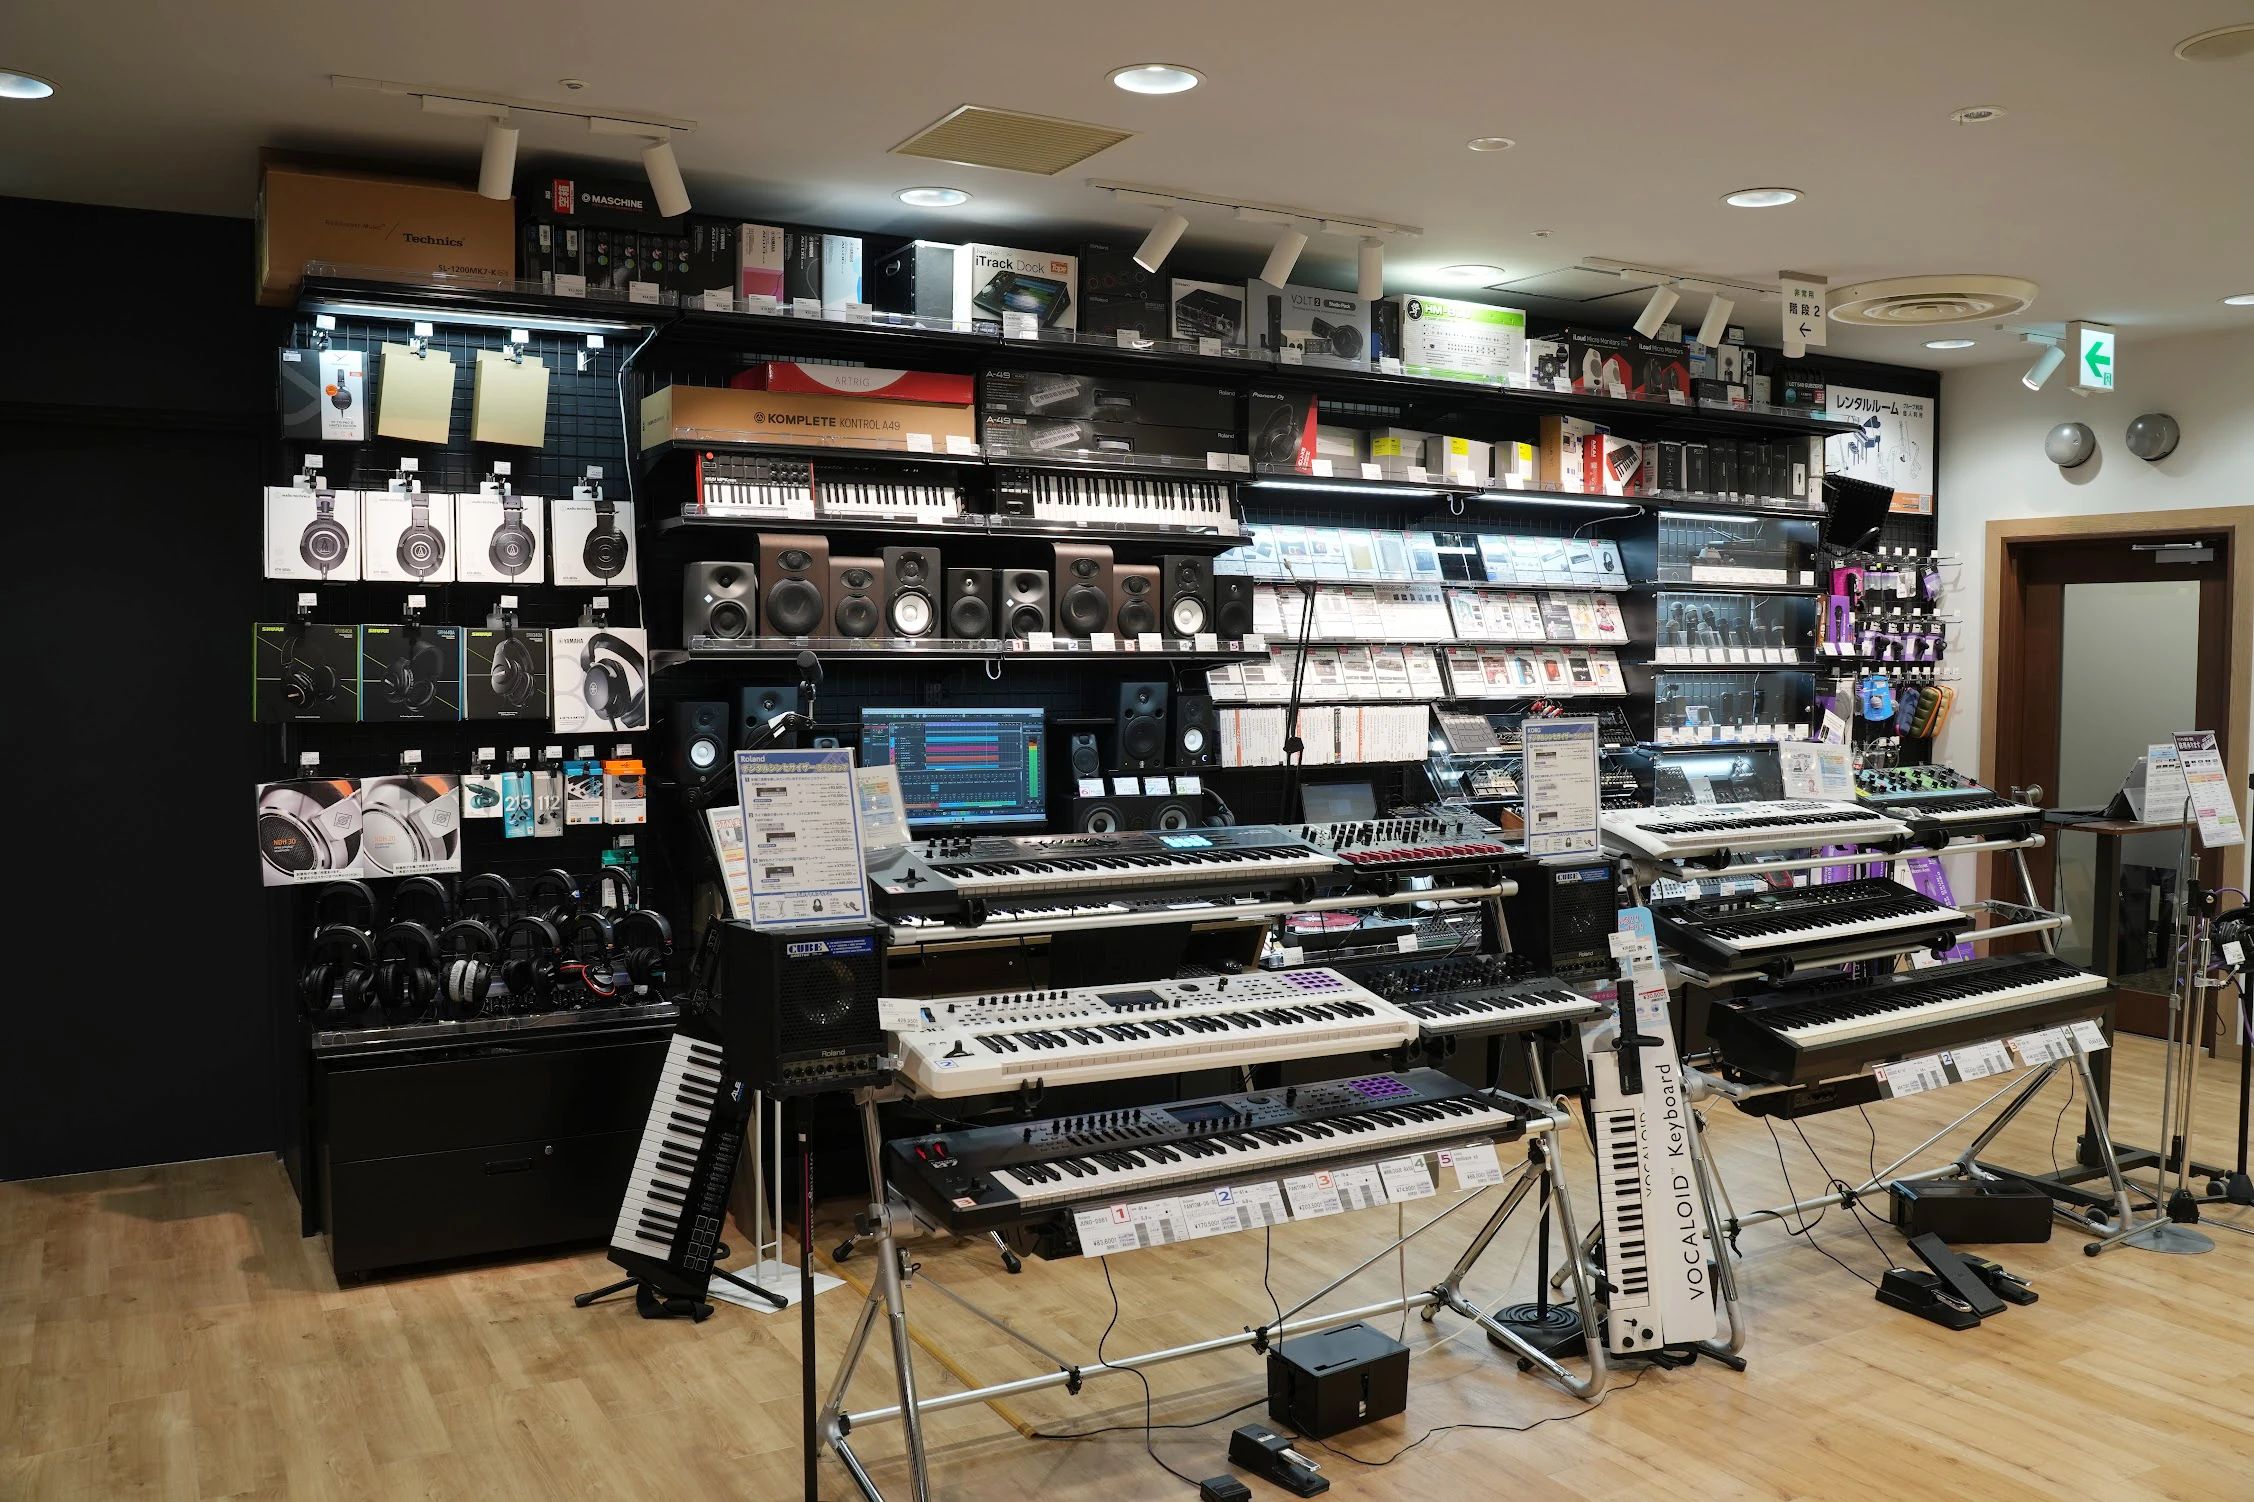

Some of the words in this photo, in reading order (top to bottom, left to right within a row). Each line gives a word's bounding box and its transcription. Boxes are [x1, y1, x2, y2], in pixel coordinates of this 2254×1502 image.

[592, 195, 643, 208] MASCHINE
[403, 233, 464, 247] Technics
[438, 264, 496, 276] SL-1200MK7-K
[975, 256, 1013, 270] iTrack
[1016, 260, 1045, 274] Dock
[1314, 298, 1320, 306] 2
[1573, 333, 1586, 342] iLoud
[1600, 338, 1620, 346] Monitors
[985, 370, 1011, 379] A-49
[1837, 394, 1899, 416] レンタルルーム
[768, 413, 836, 427] KOMPLETE
[839, 418, 881, 430] KONTROL
[882, 421, 900, 431] A49
[985, 416, 1011, 424] A-49
[505, 795, 532, 812] 215
[537, 795, 561, 810] 112
[1557, 873, 1579, 881] CUBE
[788, 943, 822, 953] CUBE
[2064, 1028, 2072, 1036] 4
[2011, 1042, 2018, 1050] 3
[821, 1049, 845, 1057] Roland
[1877, 1071, 1884, 1079] 1
[1655, 1063, 1686, 1157] Keyboard
[1415, 1159, 1425, 1168] 4
[1441, 1154, 1451, 1164] 5
[1318, 1175, 1330, 1186] 3
[1288, 1183, 1314, 1191] FANTOM-07
[1218, 1191, 1231, 1202] 2
[1115, 1208, 1125, 1219] 1
